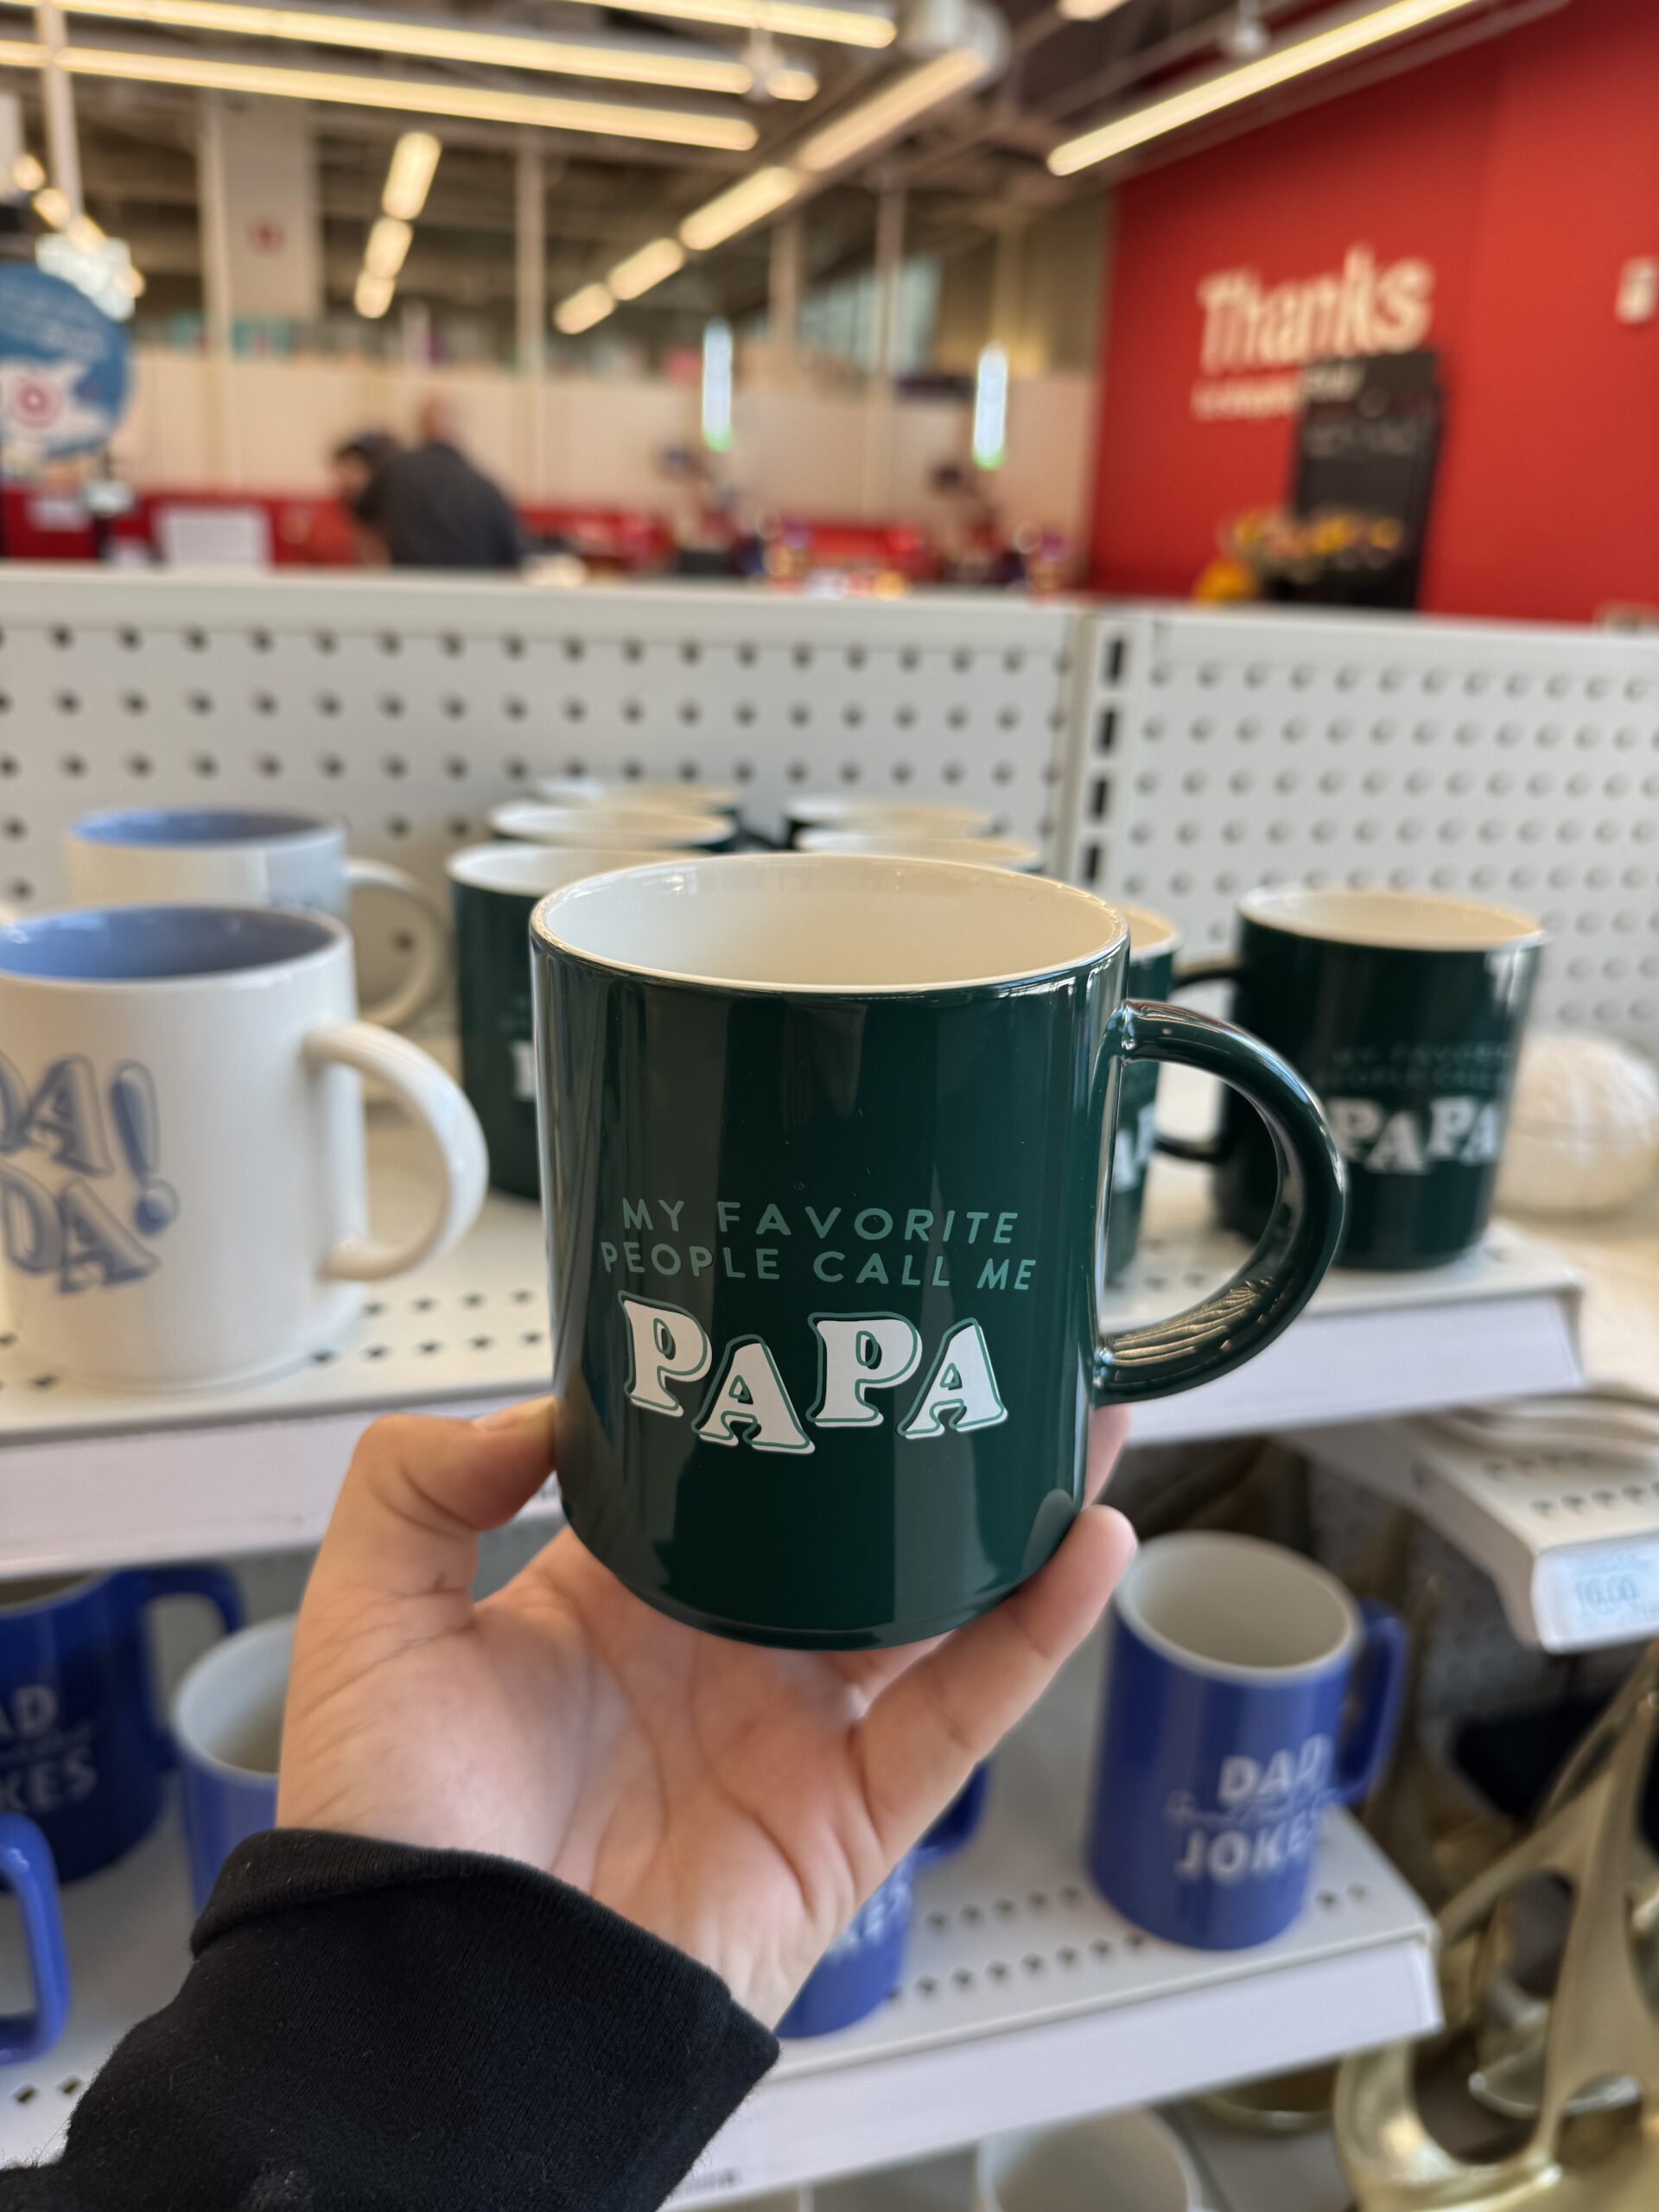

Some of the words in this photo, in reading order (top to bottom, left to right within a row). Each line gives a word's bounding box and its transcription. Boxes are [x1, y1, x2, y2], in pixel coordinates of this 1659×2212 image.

[1198, 245, 1434, 375] Thanks
[622, 1198, 685, 1232] MY
[717, 1200, 1020, 1245] FAVORITE
[600, 1240, 781, 1281] PEOPLE
[812, 1249, 951, 1287] CALL
[976, 1257, 1038, 1291] ME
[617, 1289, 1009, 1455] PAPA
[1216, 1732, 1332, 1808] DAD
[1173, 1808, 1315, 1883] JOKE
